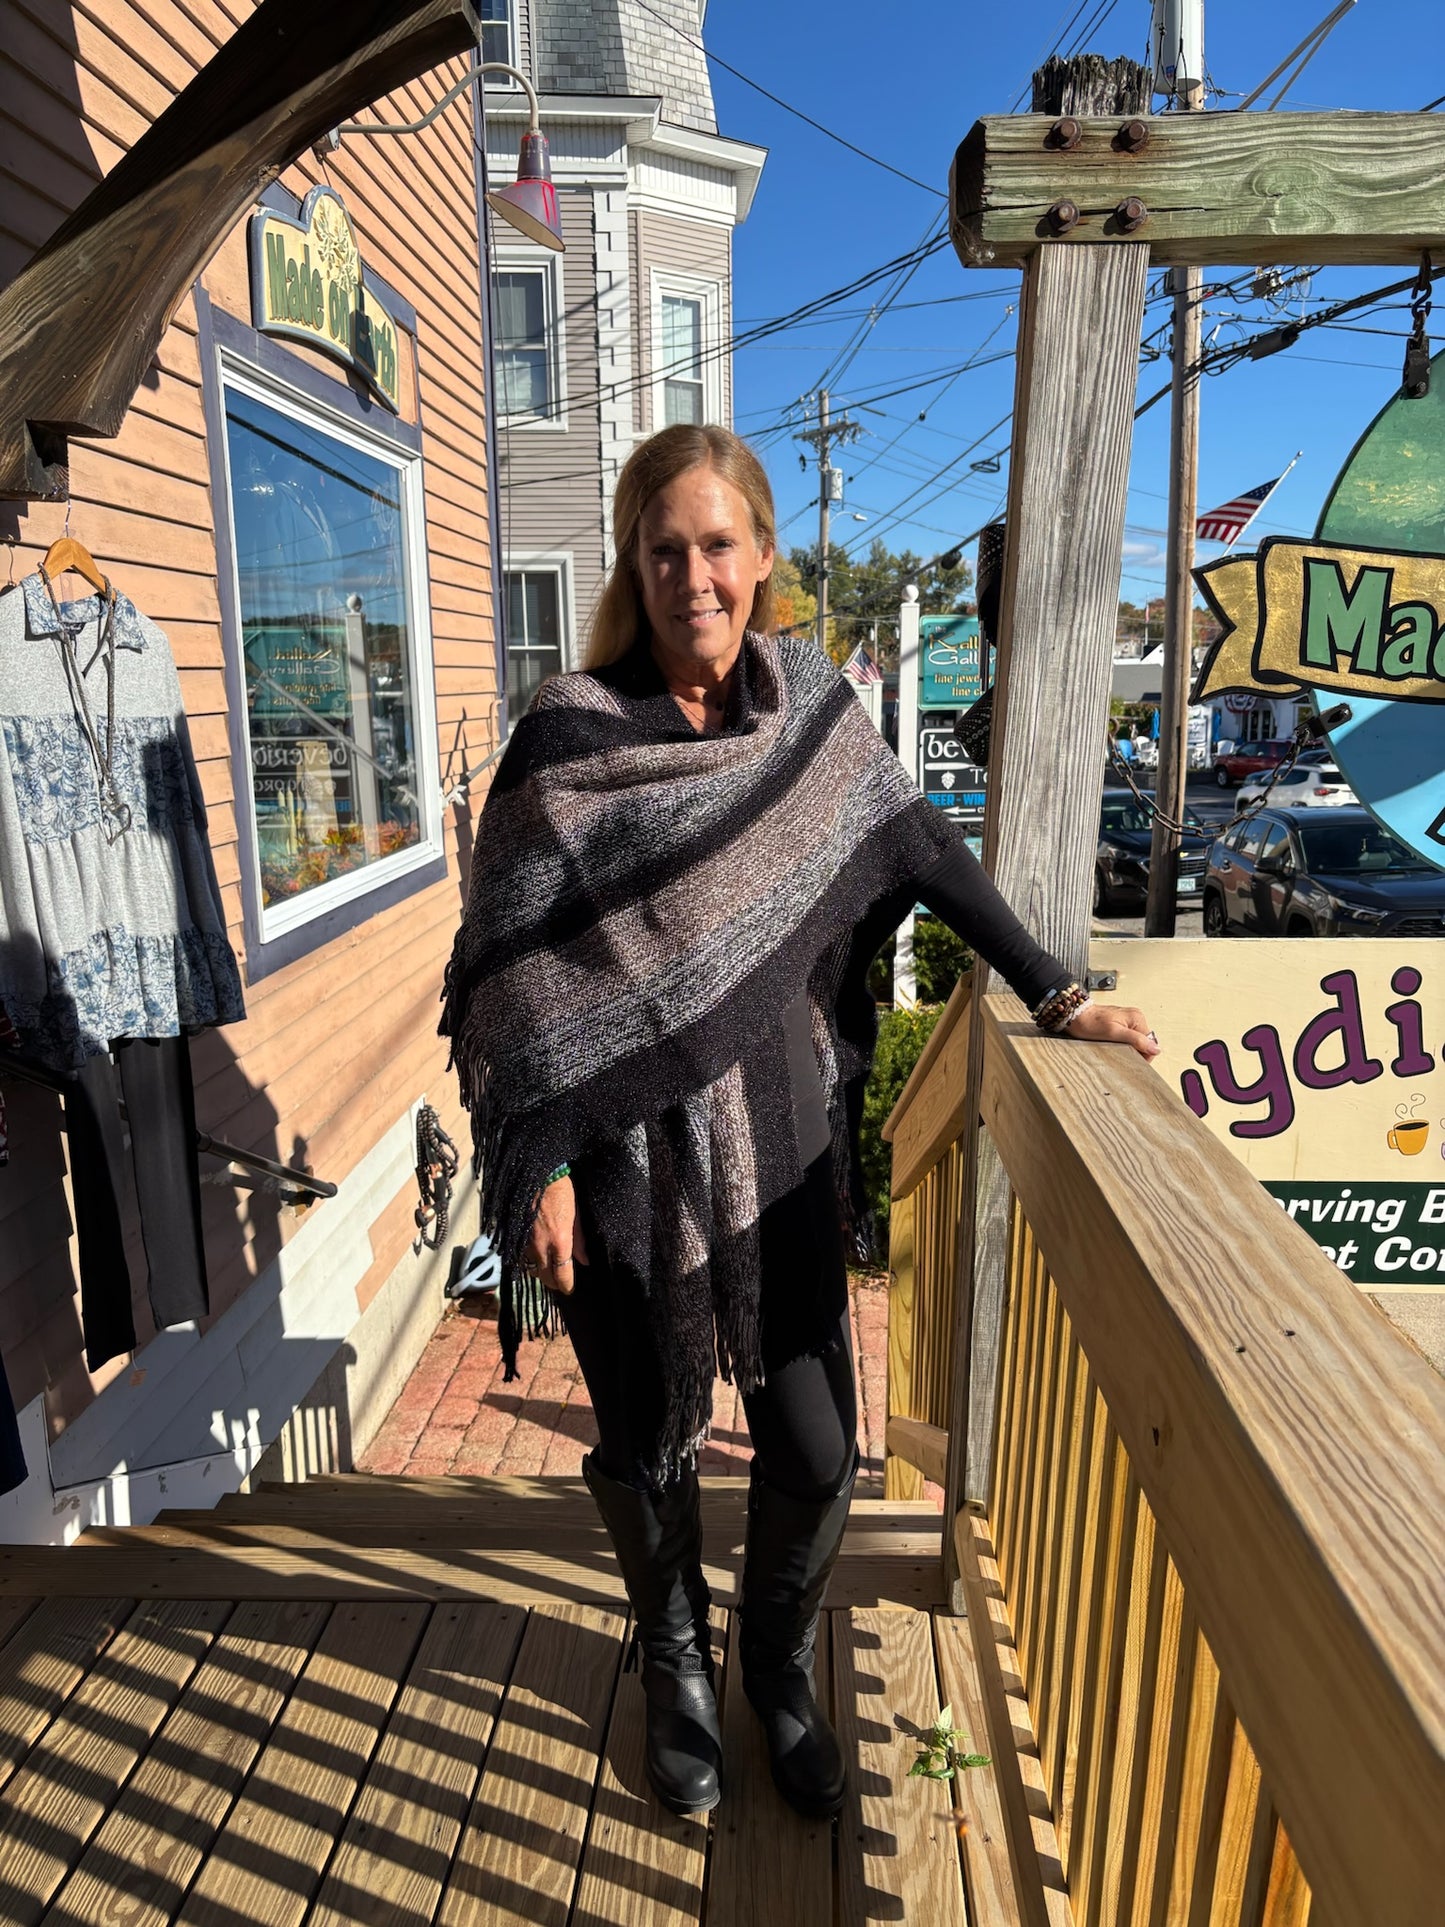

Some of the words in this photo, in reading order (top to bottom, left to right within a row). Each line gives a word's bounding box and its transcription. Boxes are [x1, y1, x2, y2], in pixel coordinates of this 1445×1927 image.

[266, 232, 325, 331] Made
[328, 279, 351, 348] on
[1181, 965, 1445, 1139] ydi
